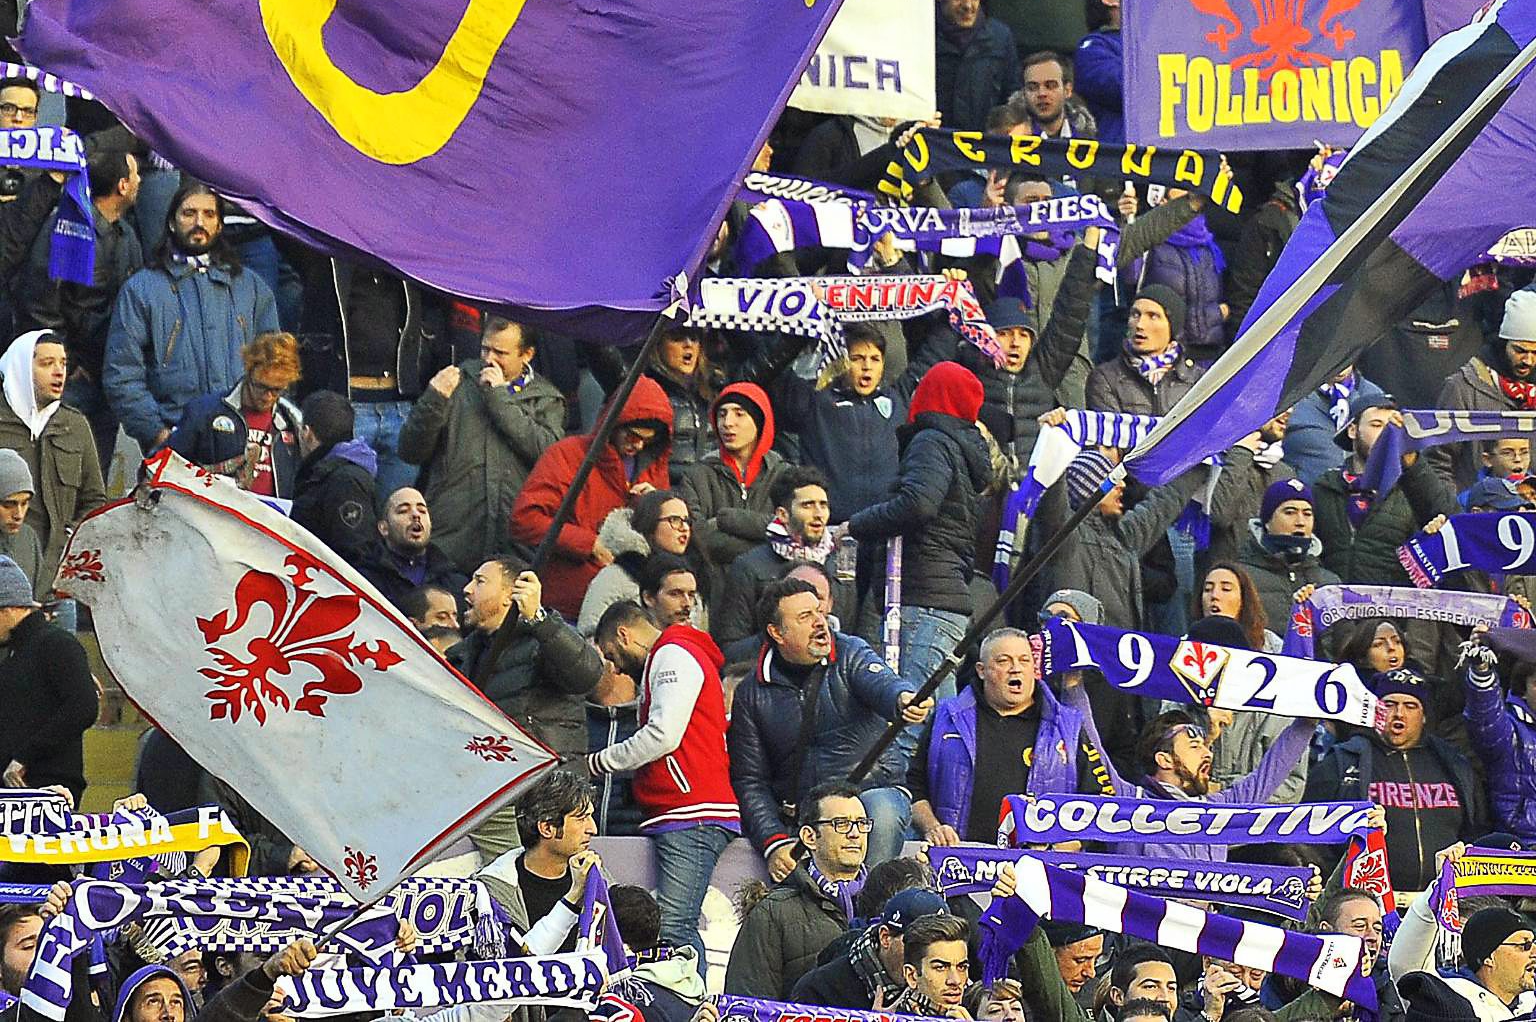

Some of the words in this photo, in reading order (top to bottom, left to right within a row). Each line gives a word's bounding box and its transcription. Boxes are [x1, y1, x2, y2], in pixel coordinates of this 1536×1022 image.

[1157, 49, 1404, 138] FOLLONICA
[1368, 781, 1461, 809] FIRENZE
[1084, 864, 1185, 890] STIRPE
[1195, 872, 1273, 896] VIOLA
[280, 966, 428, 1015] JUVE
[436, 956, 605, 1004] MERDA
